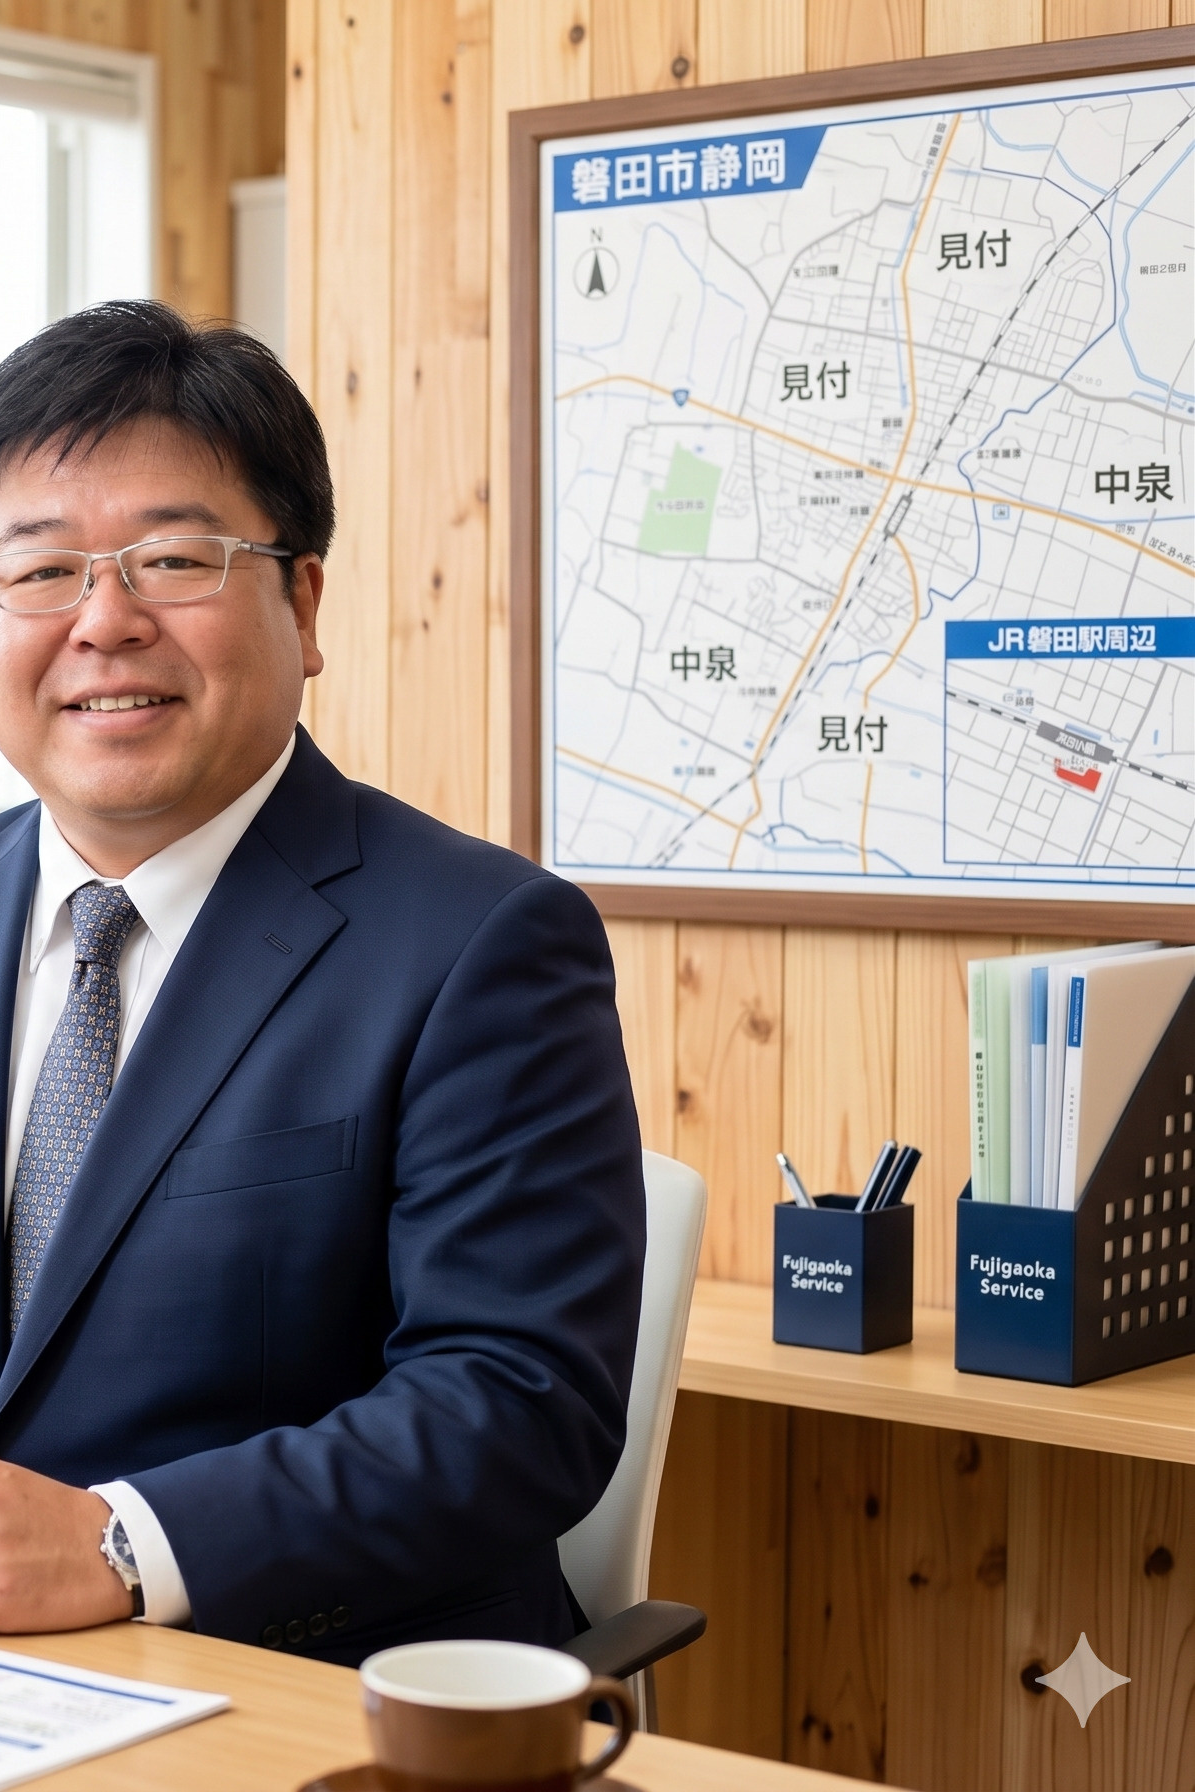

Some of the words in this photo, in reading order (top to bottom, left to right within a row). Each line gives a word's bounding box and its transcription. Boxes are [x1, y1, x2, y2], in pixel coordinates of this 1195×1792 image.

[572, 138, 786, 204] 磐田市静岡
[591, 226, 603, 243] N
[936, 229, 1011, 271] 見付
[780, 360, 850, 402] 見付
[1095, 462, 1174, 504] 中泉
[988, 625, 1156, 653] JR磐田駅周辺
[671, 645, 737, 682] 中泉
[818, 715, 888, 752] 見付
[783, 1254, 853, 1277] Fujigaoka
[970, 1254, 1056, 1280] Fujigaoka
[791, 1273, 844, 1294] Service
[980, 1278, 1045, 1301] Service
